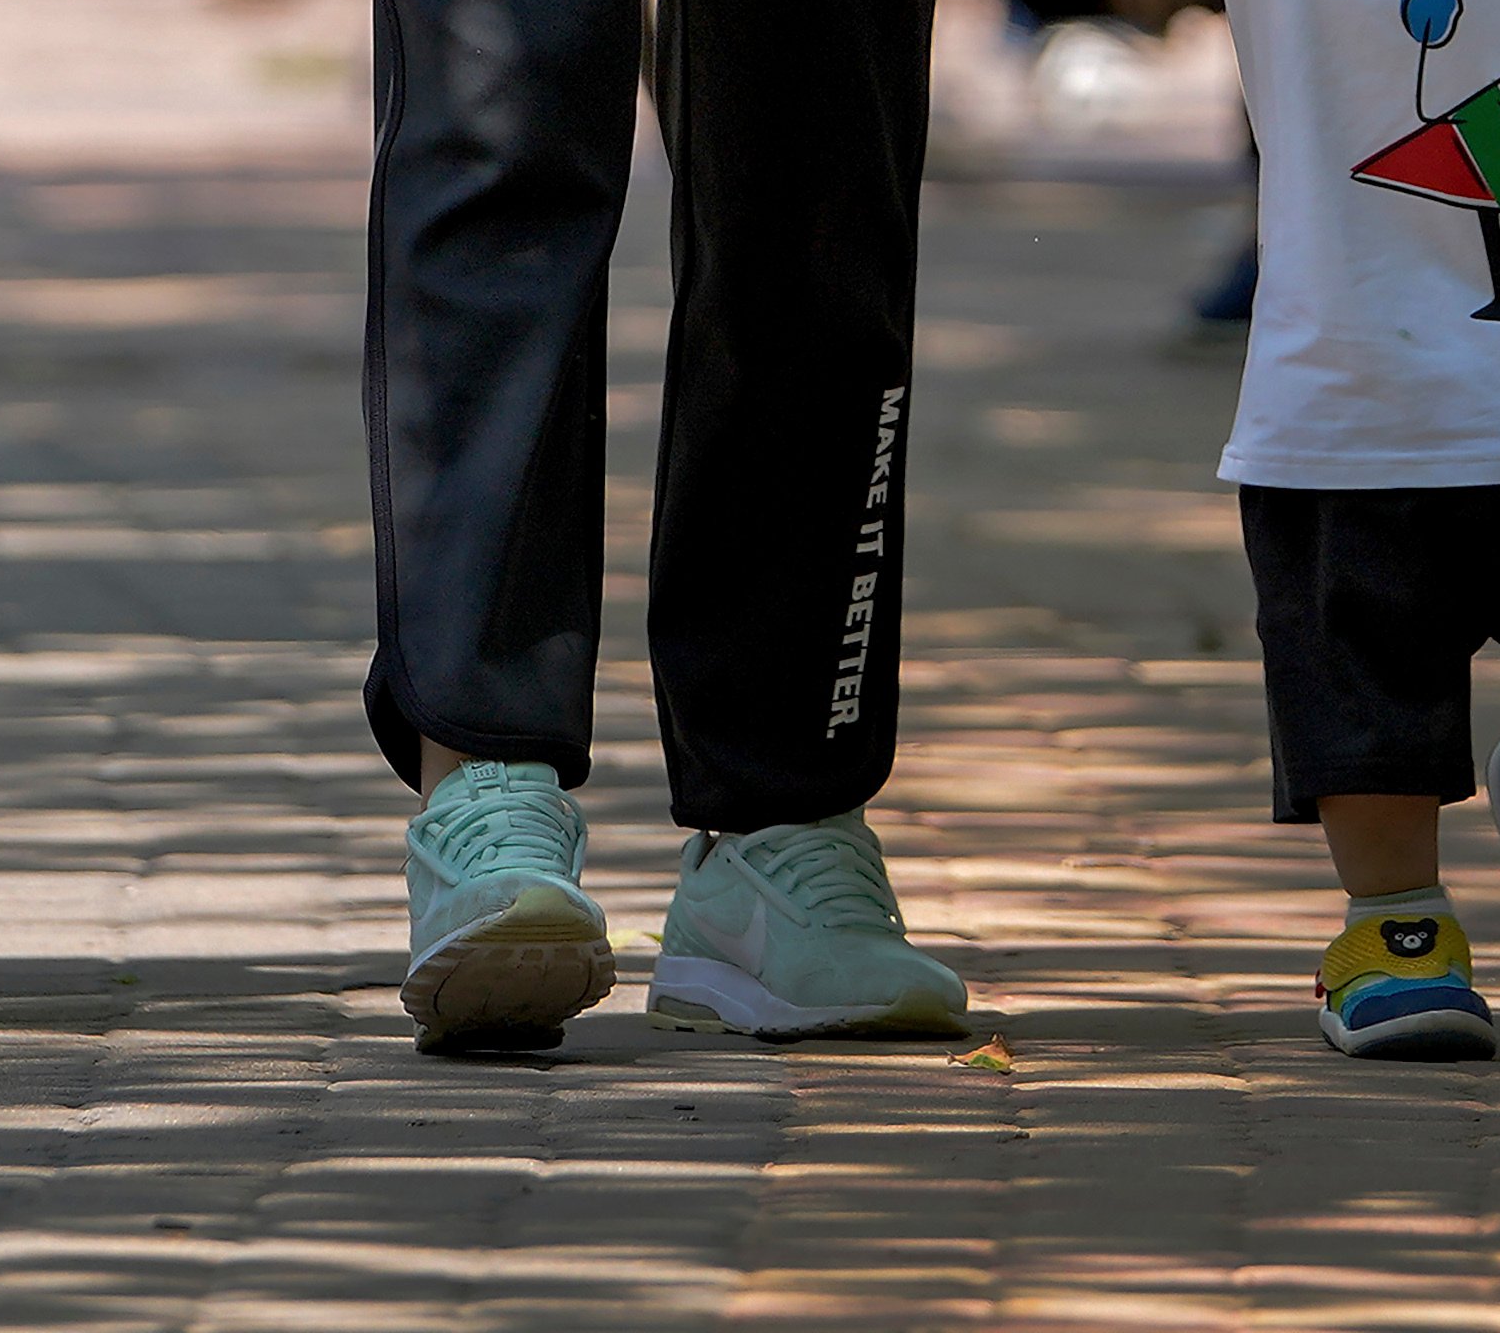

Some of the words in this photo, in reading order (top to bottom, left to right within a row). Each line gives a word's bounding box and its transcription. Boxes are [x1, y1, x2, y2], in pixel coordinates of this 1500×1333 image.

[866, 386, 905, 509] MAKE
[856, 520, 885, 557] IT
[826, 571, 878, 739] BETTER.
